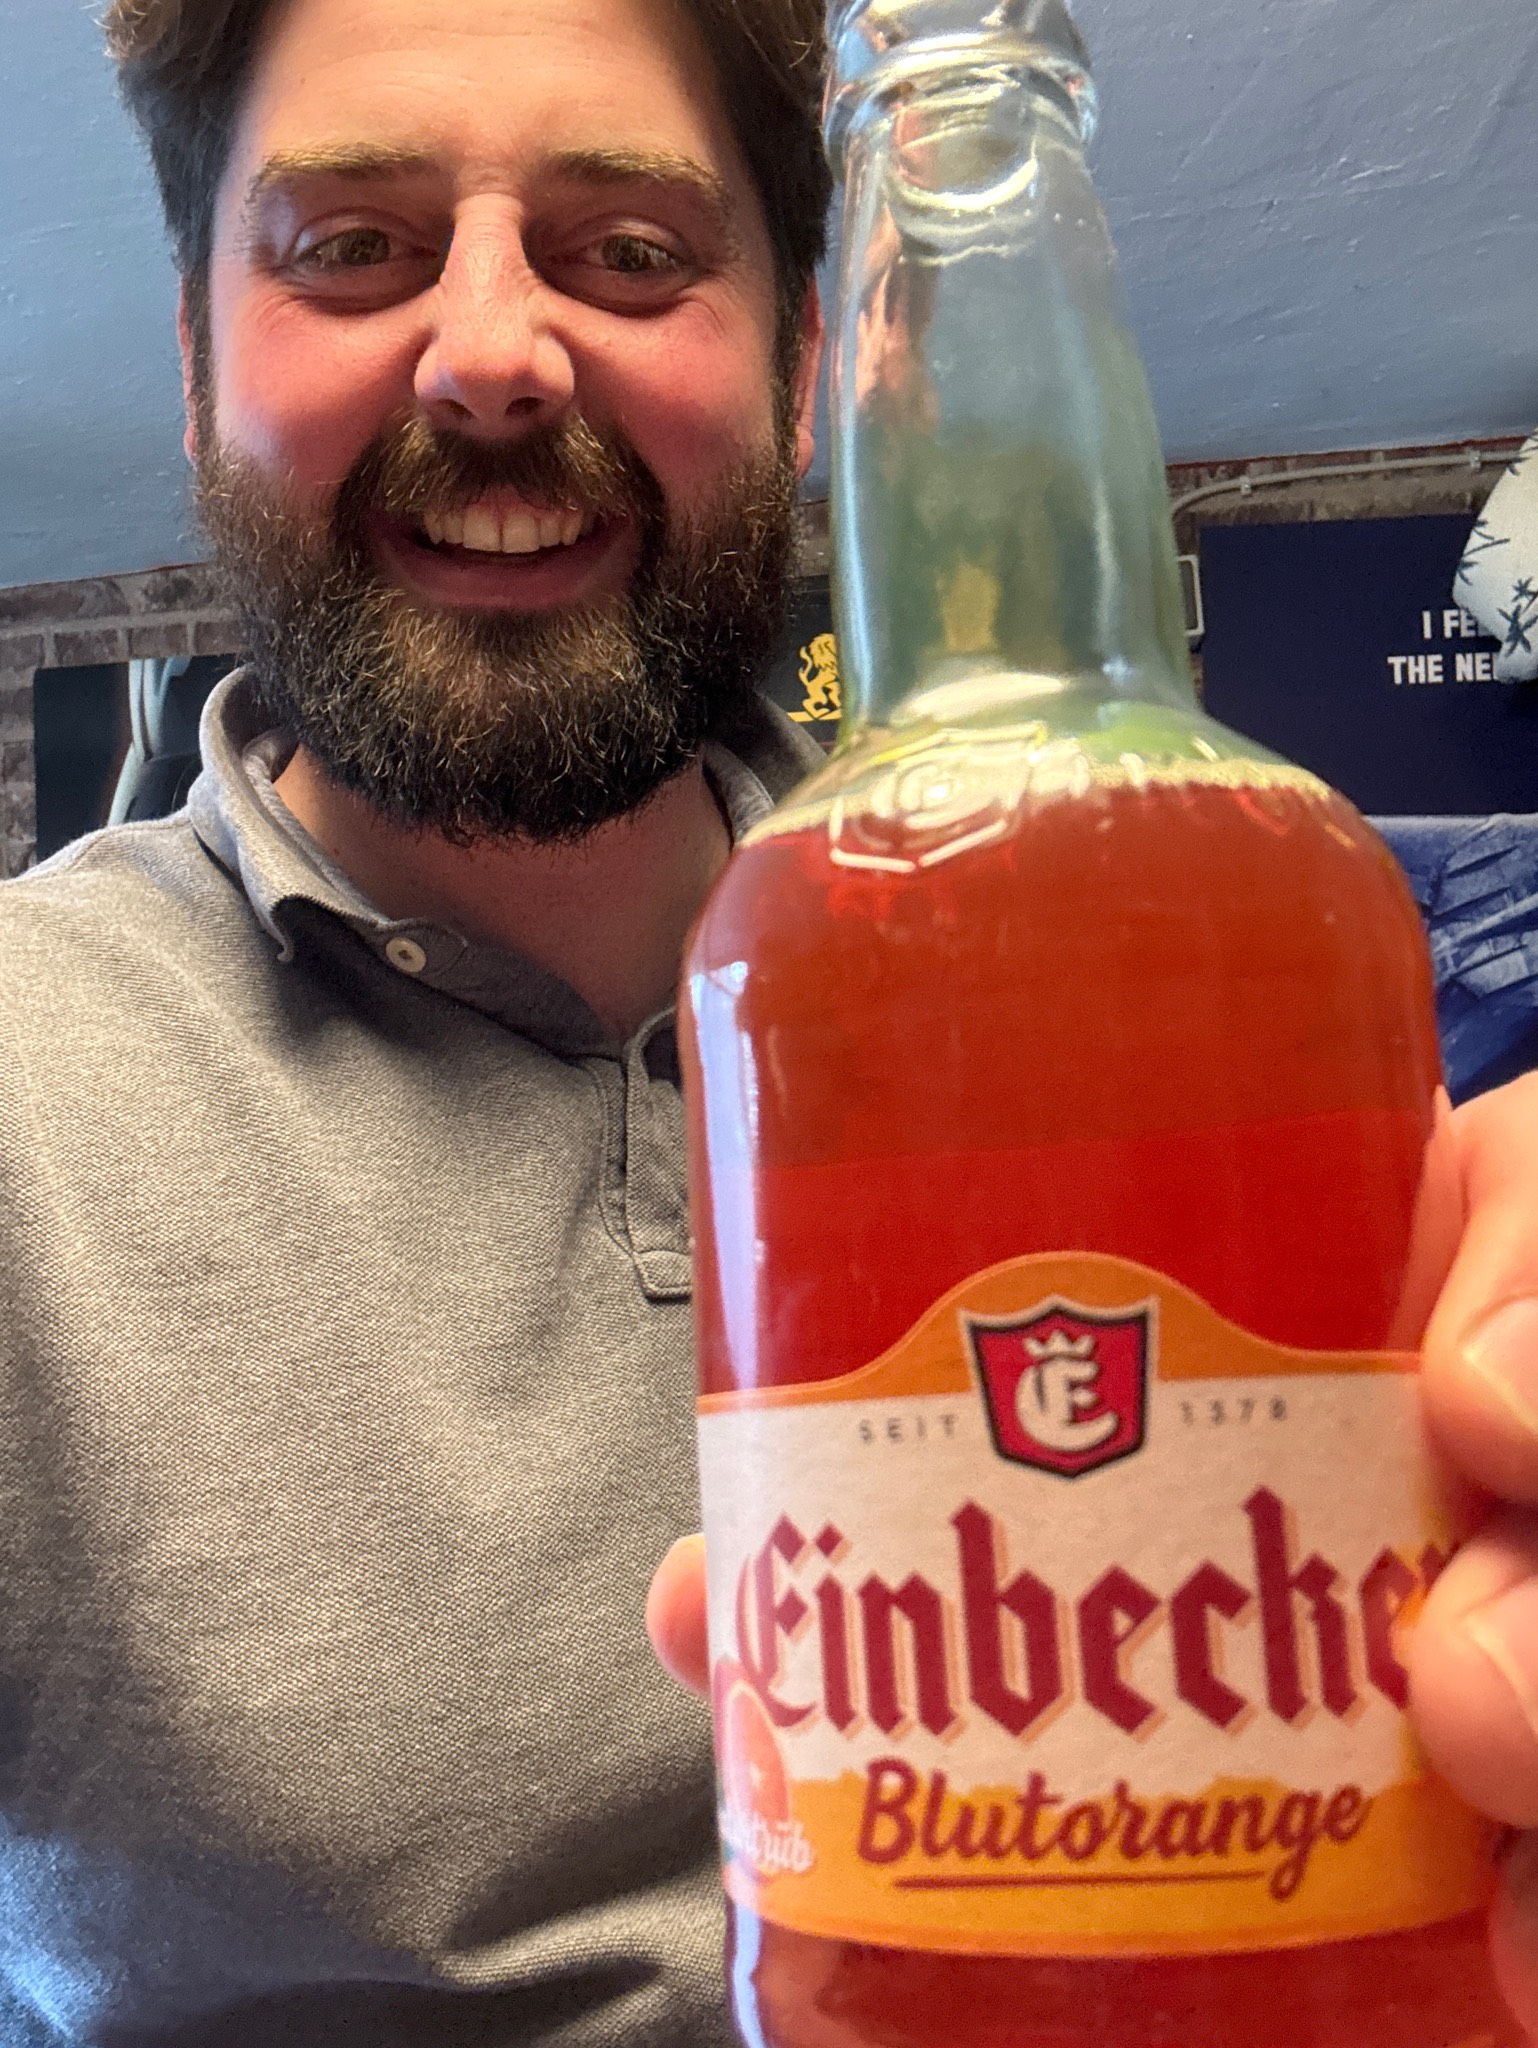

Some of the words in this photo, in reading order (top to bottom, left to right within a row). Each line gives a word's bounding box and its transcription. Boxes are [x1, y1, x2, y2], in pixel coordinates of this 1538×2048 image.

[1422, 610, 1432, 640] I
[1443, 608, 1478, 639] FE
[1387, 653, 1444, 685] THE
[1455, 652, 1500, 683] NE
[857, 1412, 957, 1445] SEIT
[1180, 1397, 1288, 1426] 1378
[857, 1756, 1371, 1902] Blutorange
